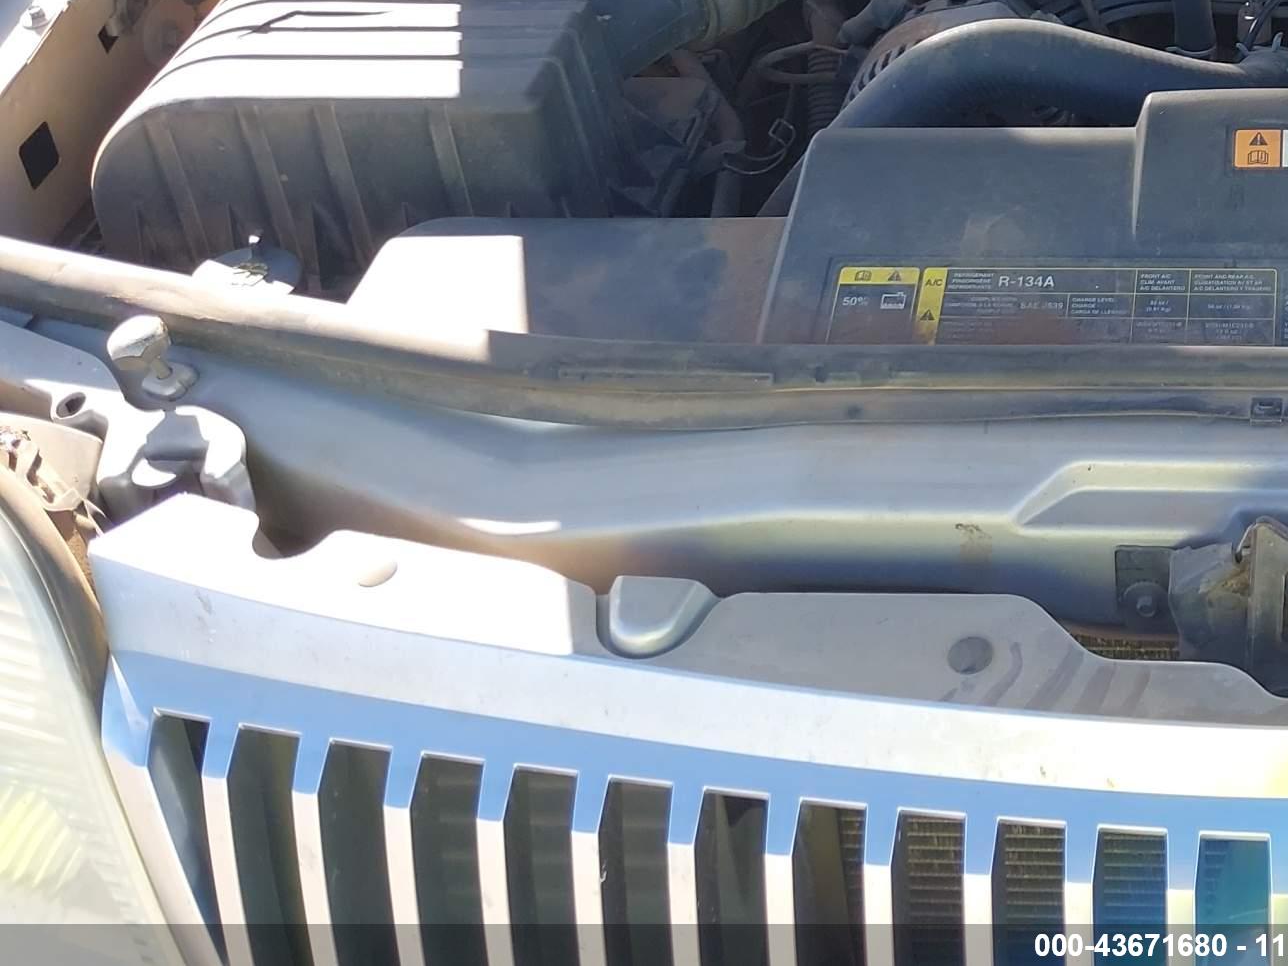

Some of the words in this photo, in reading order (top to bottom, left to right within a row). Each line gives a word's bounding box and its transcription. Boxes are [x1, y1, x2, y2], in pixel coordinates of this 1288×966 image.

[925, 278, 943, 287] A/C
[998, 275, 1056, 288] R-134A
[842, 296, 870, 307] 50%
